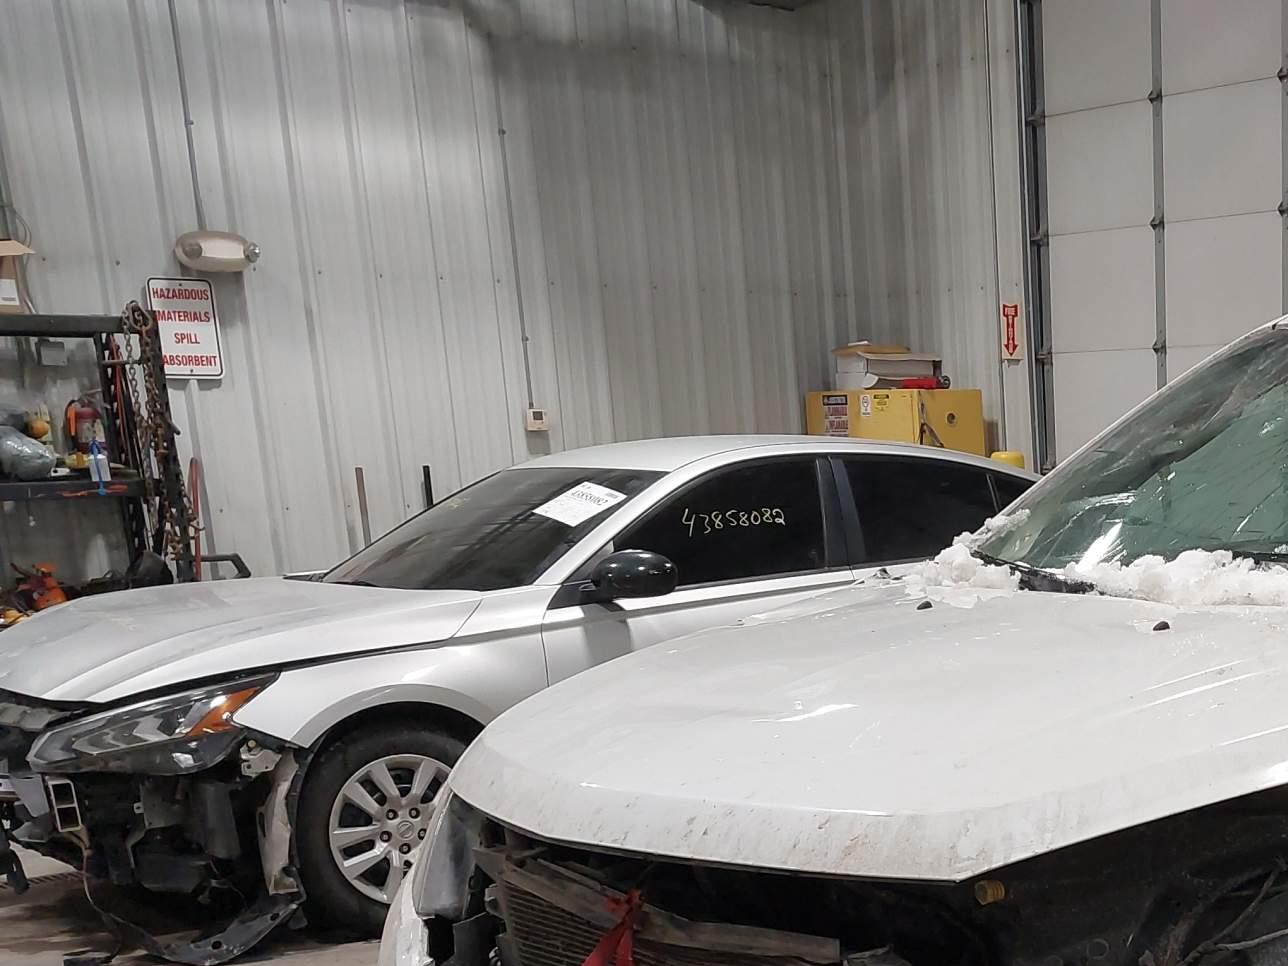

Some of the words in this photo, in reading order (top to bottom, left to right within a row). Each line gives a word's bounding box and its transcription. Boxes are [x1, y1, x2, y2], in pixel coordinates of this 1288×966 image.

[152, 287, 209, 301] HAZARDOUS
[155, 310, 211, 323] MATERIALS
[174, 332, 201, 345] SPILL
[162, 354, 217, 367] ABSORBENT
[681, 508, 786, 537] 43858082
